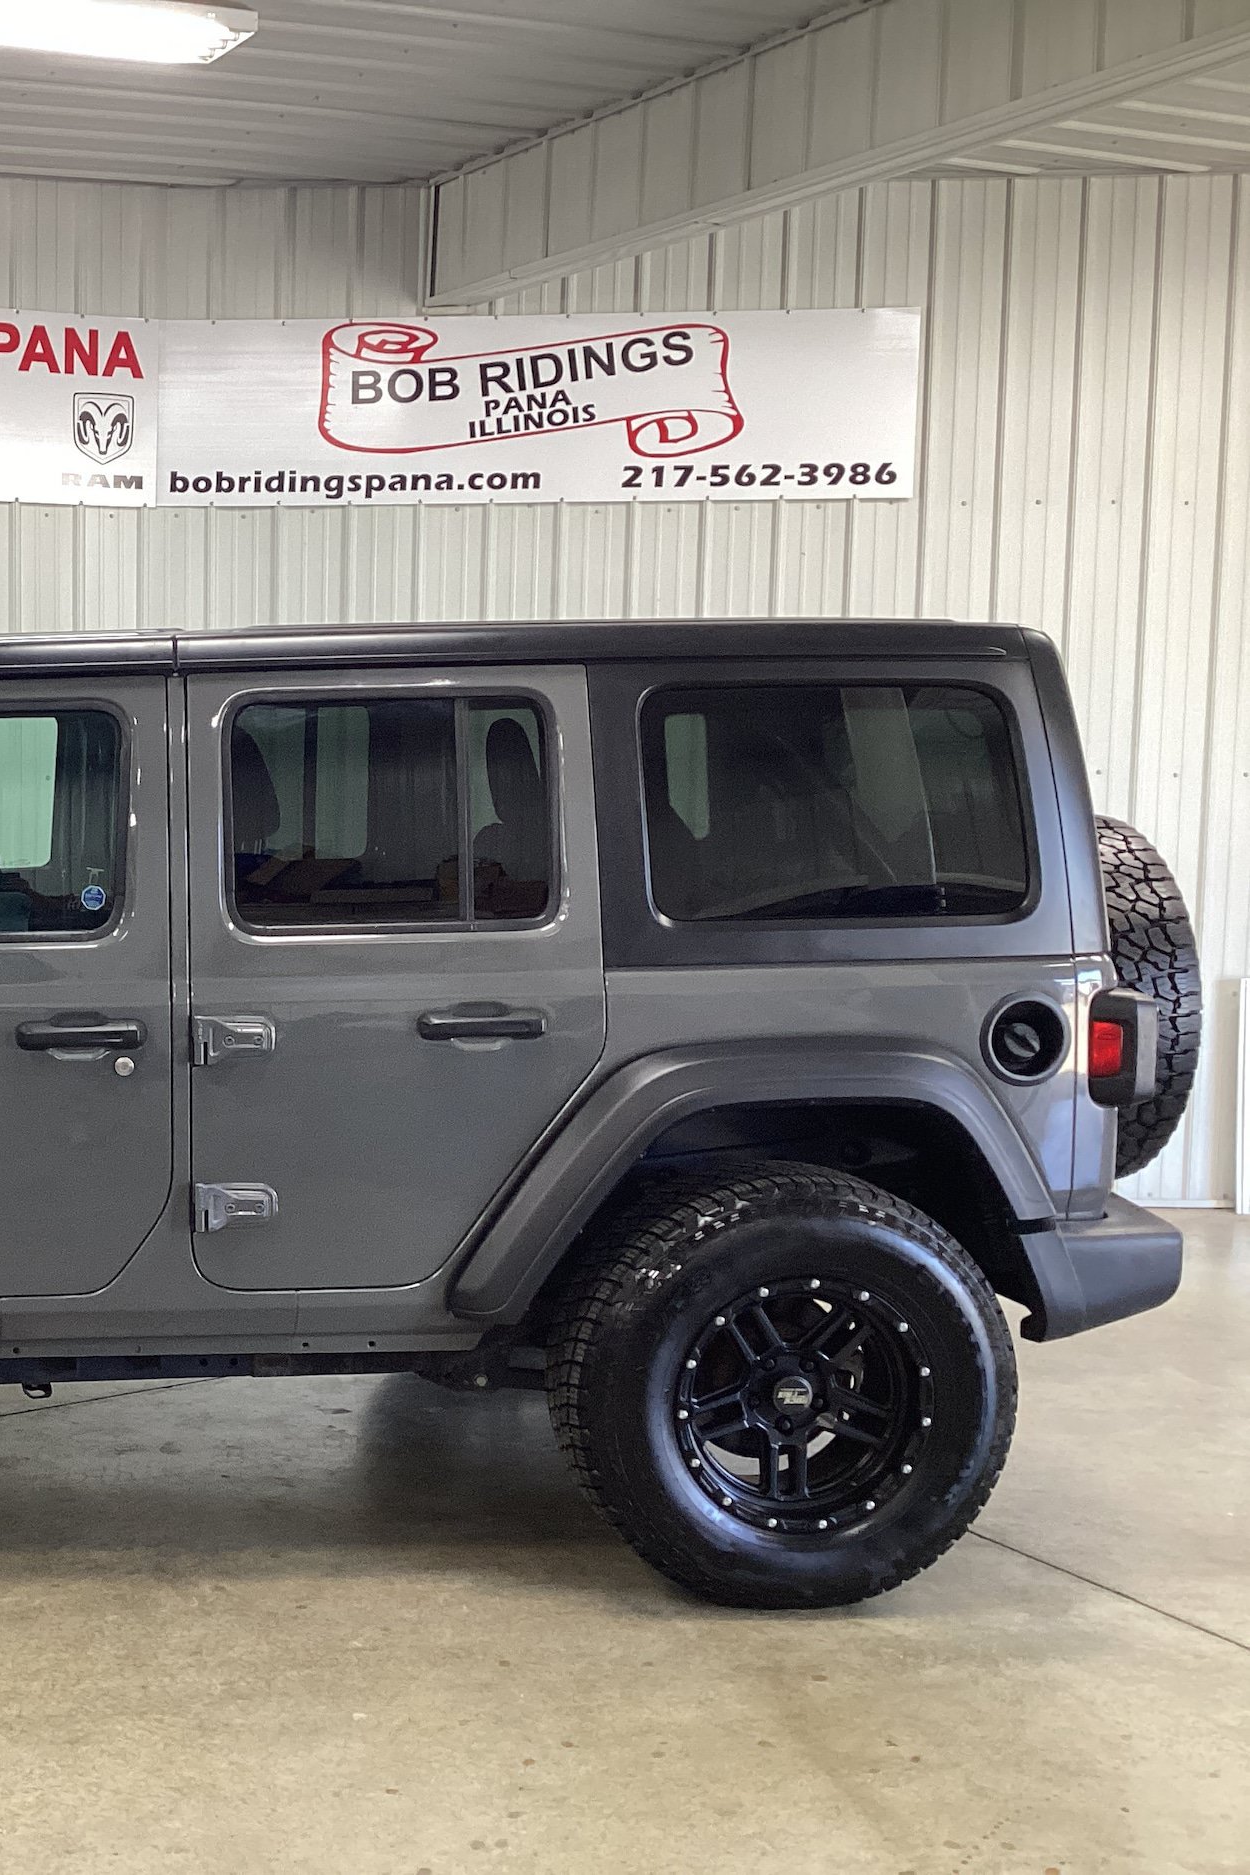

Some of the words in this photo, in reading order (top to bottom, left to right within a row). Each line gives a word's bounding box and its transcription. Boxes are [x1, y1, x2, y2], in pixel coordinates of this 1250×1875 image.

[350, 365, 461, 406] BOB
[478, 329, 695, 398] RIDINGS
[483, 388, 574, 418] PANA
[468, 403, 597, 440] ILLINOIS
[61, 471, 144, 490] RAM
[168, 469, 542, 500] bobridingspana.com
[620, 461, 898, 488] 217-562-3986
